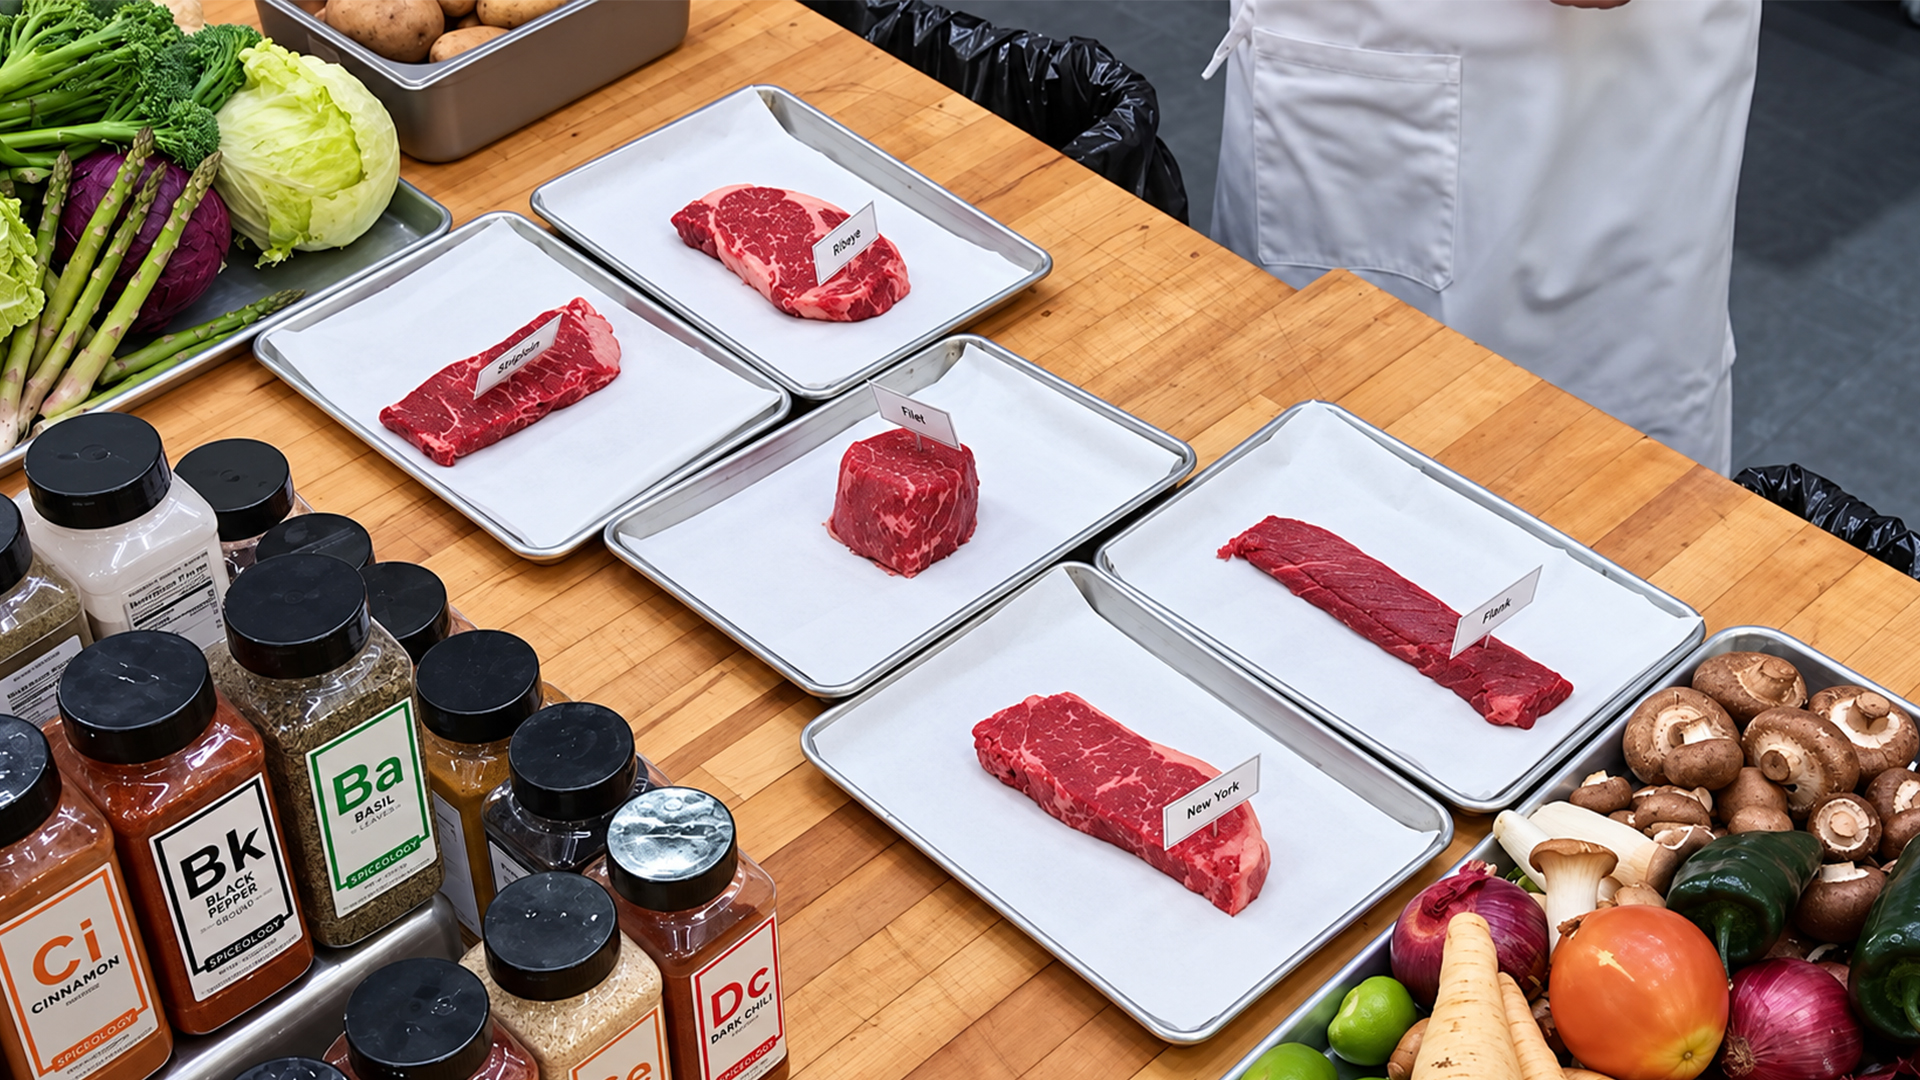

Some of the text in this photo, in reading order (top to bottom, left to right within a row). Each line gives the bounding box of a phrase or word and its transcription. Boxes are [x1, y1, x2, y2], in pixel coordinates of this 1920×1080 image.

[901, 405, 926, 425] Filet
[1482, 597, 1512, 624] Flank
[332, 756, 404, 816] Ba
[354, 795, 395, 823] BASIL
[1187, 781, 1240, 819] New York
[179, 827, 266, 901] Bk
[350, 840, 417, 885] SPICEOLOGY
[205, 871, 255, 908] BLACK
[208, 882, 258, 918] PEPPER
[32, 917, 102, 986] Ci
[209, 918, 281, 968] SPICEOLOGY
[31, 955, 120, 1014] CINNAMON
[57, 1012, 134, 1067] SPICEOLOGY
[710, 1016, 742, 1045] DARK
[744, 993, 773, 1019] CHILI
